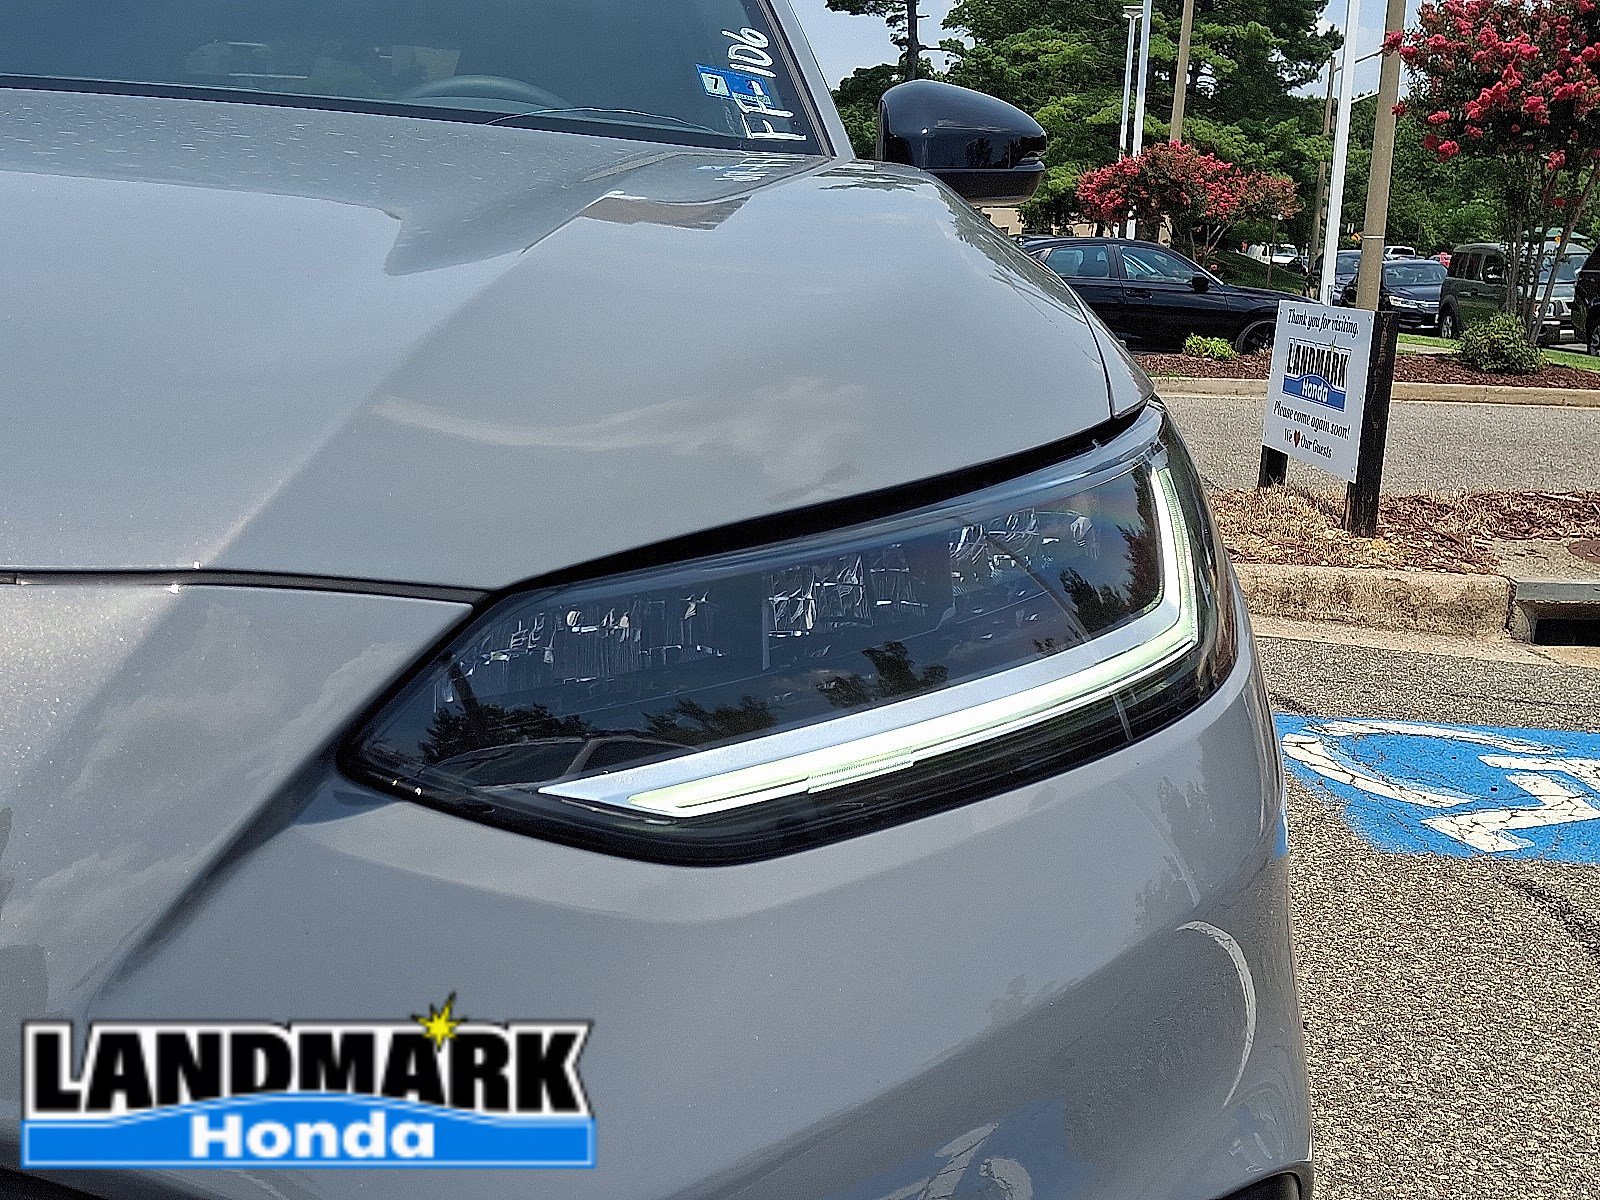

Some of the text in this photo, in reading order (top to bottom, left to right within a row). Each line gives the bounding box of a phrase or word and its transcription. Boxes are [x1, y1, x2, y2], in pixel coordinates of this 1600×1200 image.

[707, 76, 719, 90] 7
[1287, 308, 1307, 326] Thank
[1306, 315, 1320, 330] you
[1318, 312, 1332, 332] for
[1286, 341, 1349, 389] LANDMARK
[1301, 378, 1329, 403] Honda
[1273, 400, 1351, 441] Please come again soon!
[1284, 427, 1333, 459] We Our Guests
